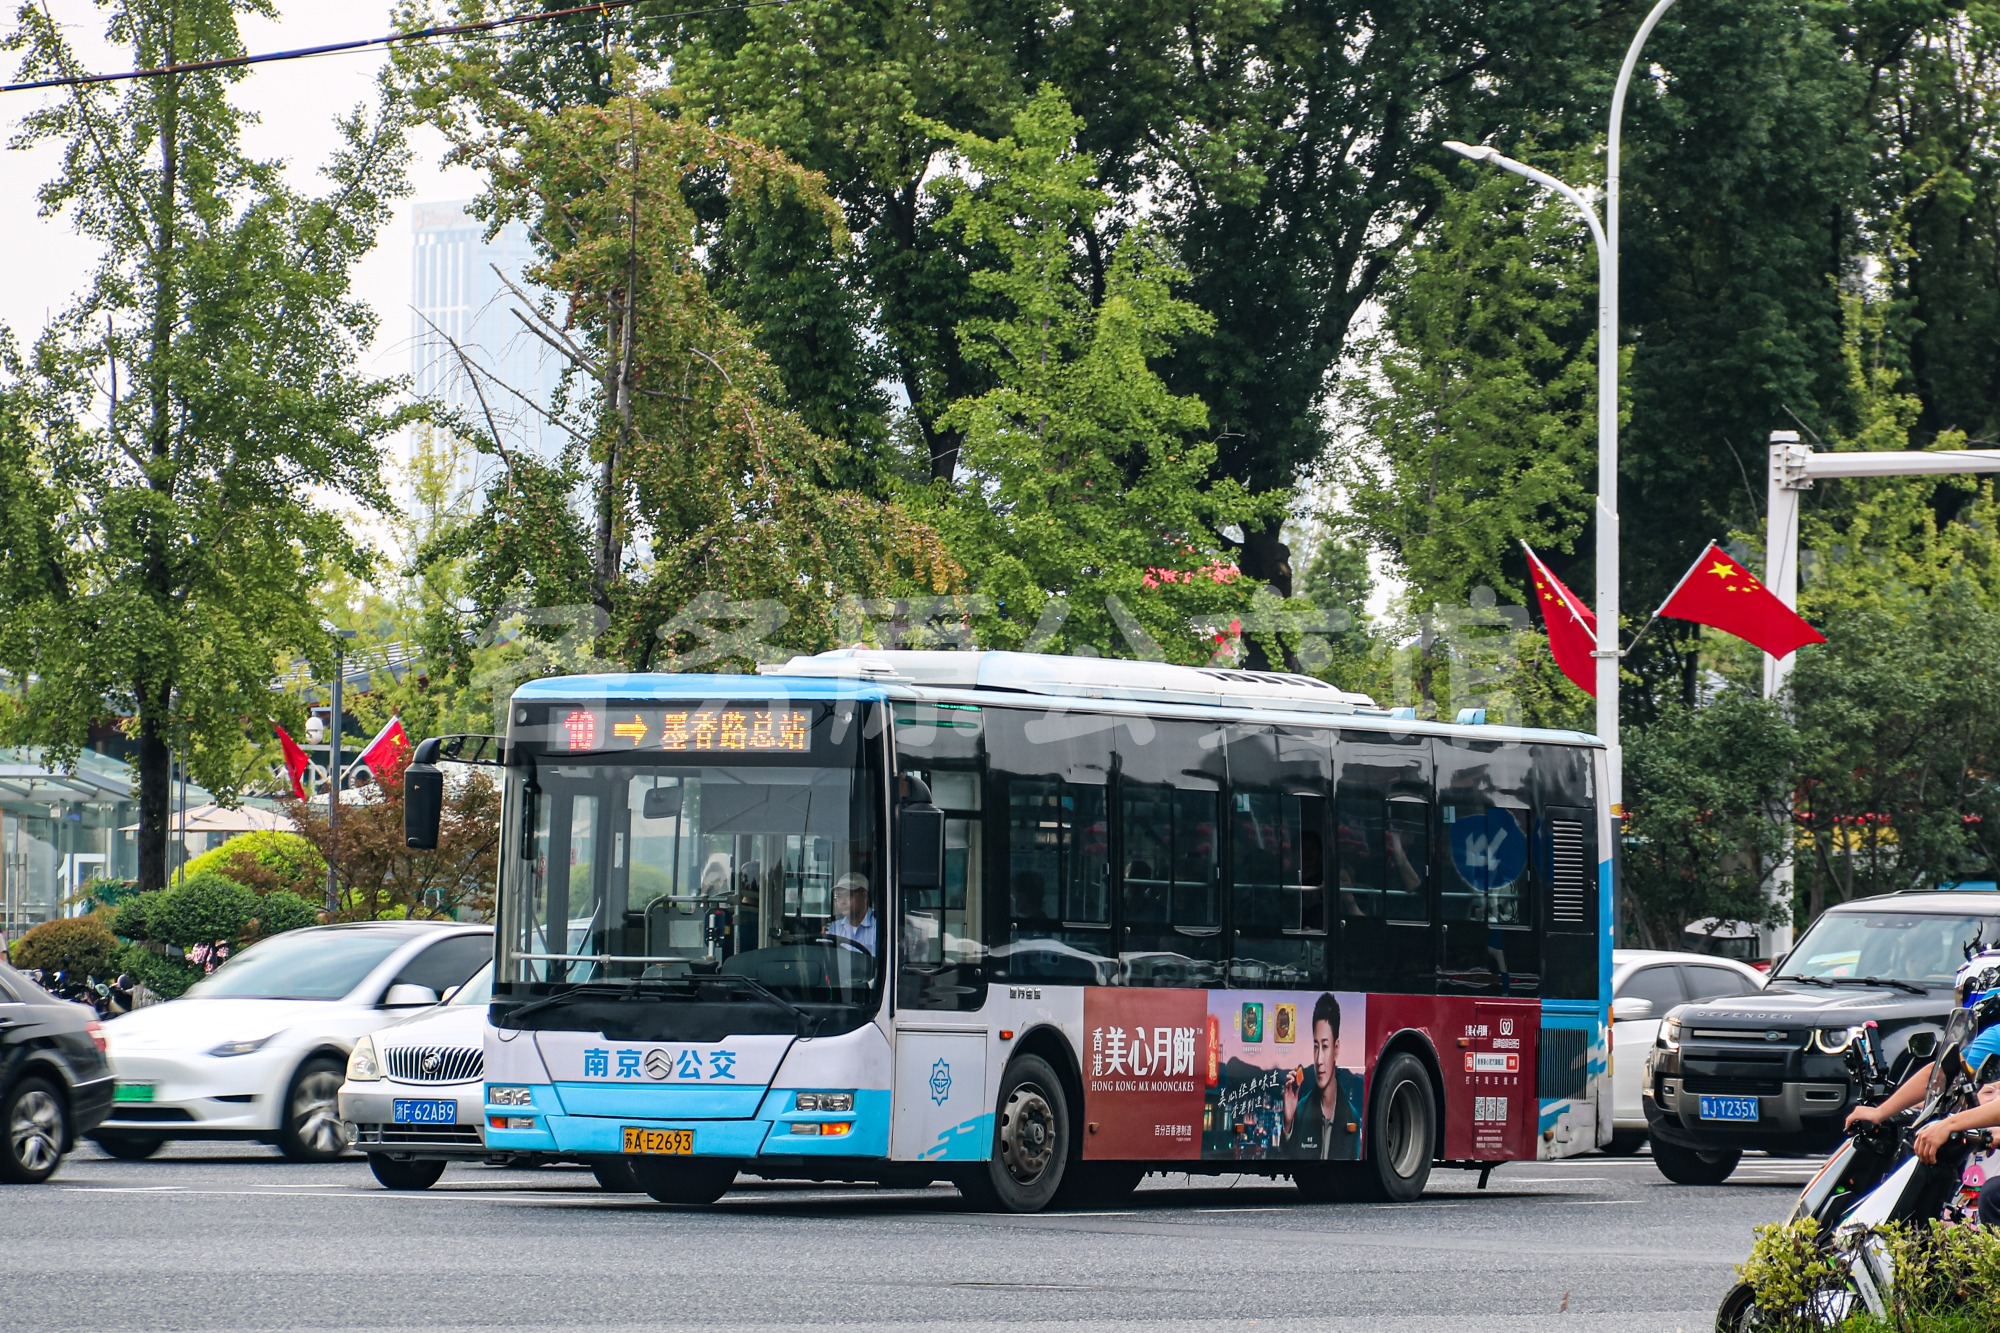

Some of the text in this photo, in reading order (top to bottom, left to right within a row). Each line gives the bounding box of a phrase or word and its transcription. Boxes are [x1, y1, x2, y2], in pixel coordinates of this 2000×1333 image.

[563, 709, 594, 751] 10
[661, 710, 807, 752] 墨香路总站
[1697, 1011, 1792, 1020] DEFENDER
[584, 1047, 737, 1080] 南京 公交
[1091, 1027, 1103, 1077] 香港
[1104, 1026, 1195, 1077] 美心月餅
[1091, 1081, 1195, 1092] HONG KONG MX MOONCAKES
